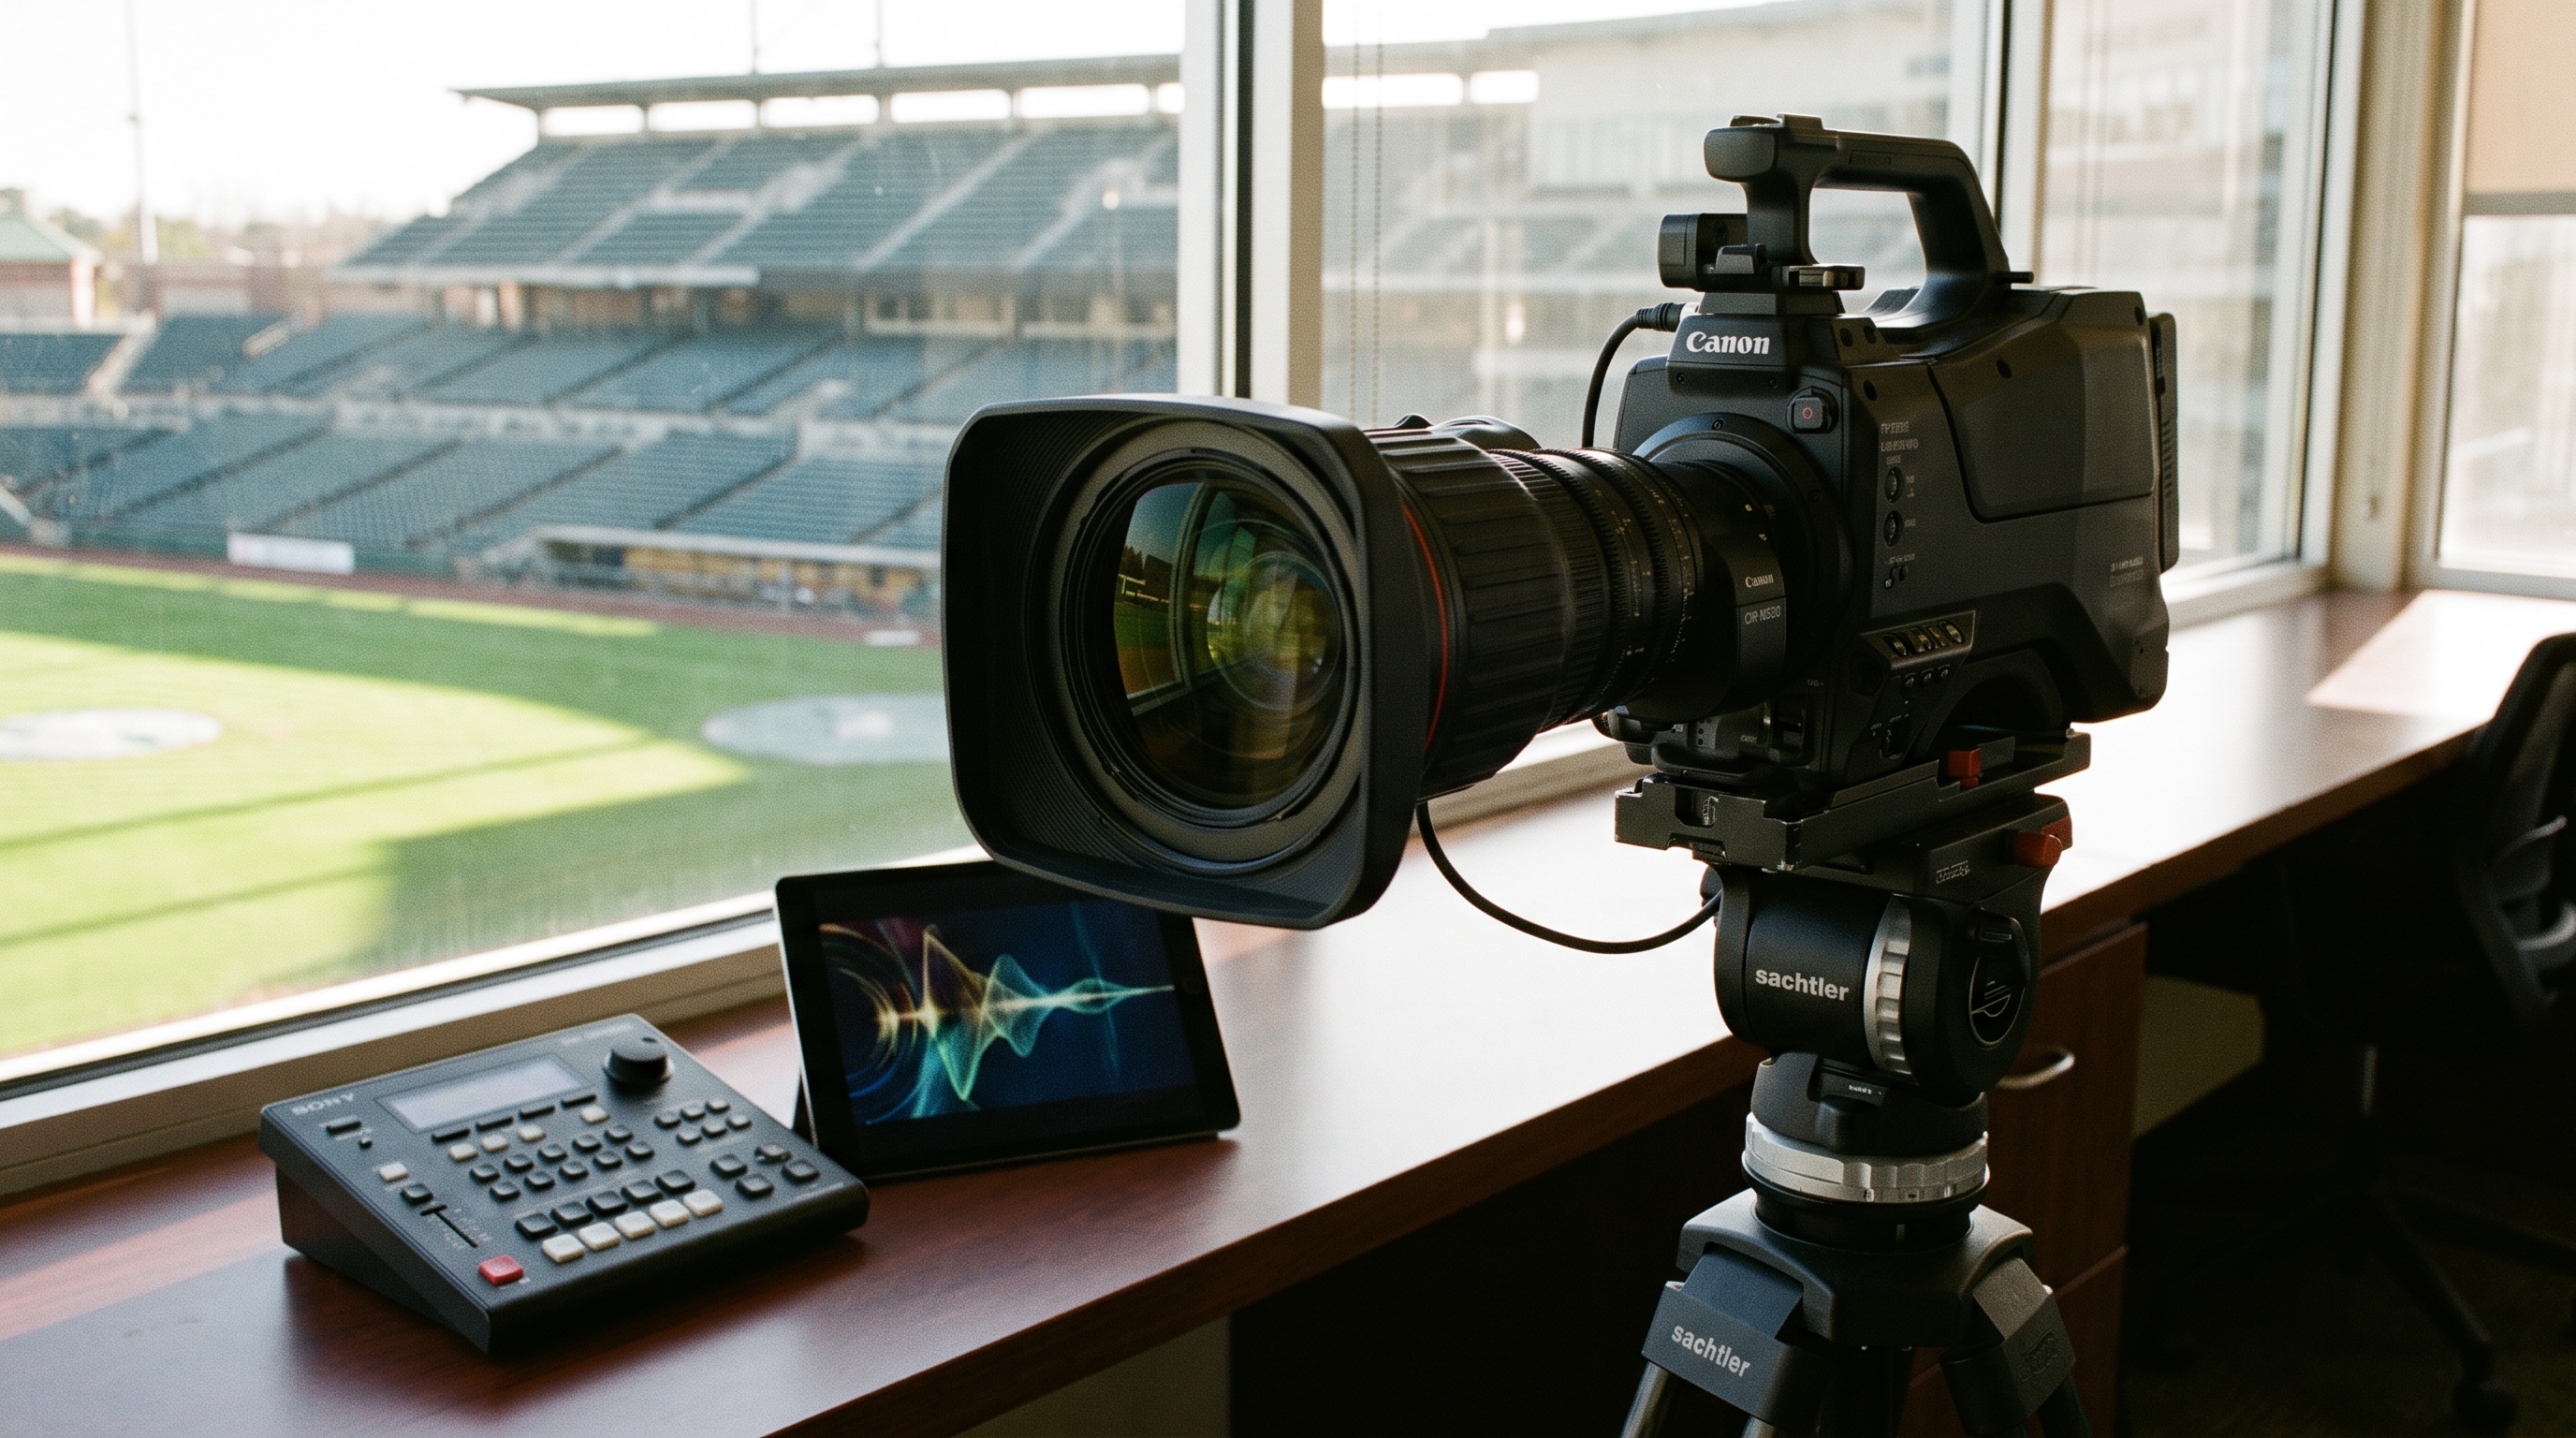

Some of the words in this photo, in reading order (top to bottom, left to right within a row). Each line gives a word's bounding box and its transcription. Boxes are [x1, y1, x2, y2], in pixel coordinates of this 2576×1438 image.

[1686, 330, 1770, 355] Canon
[1755, 969, 1850, 1001] sachtler
[291, 1093, 354, 1116] SONY
[1671, 1325, 1751, 1377] sachtler
